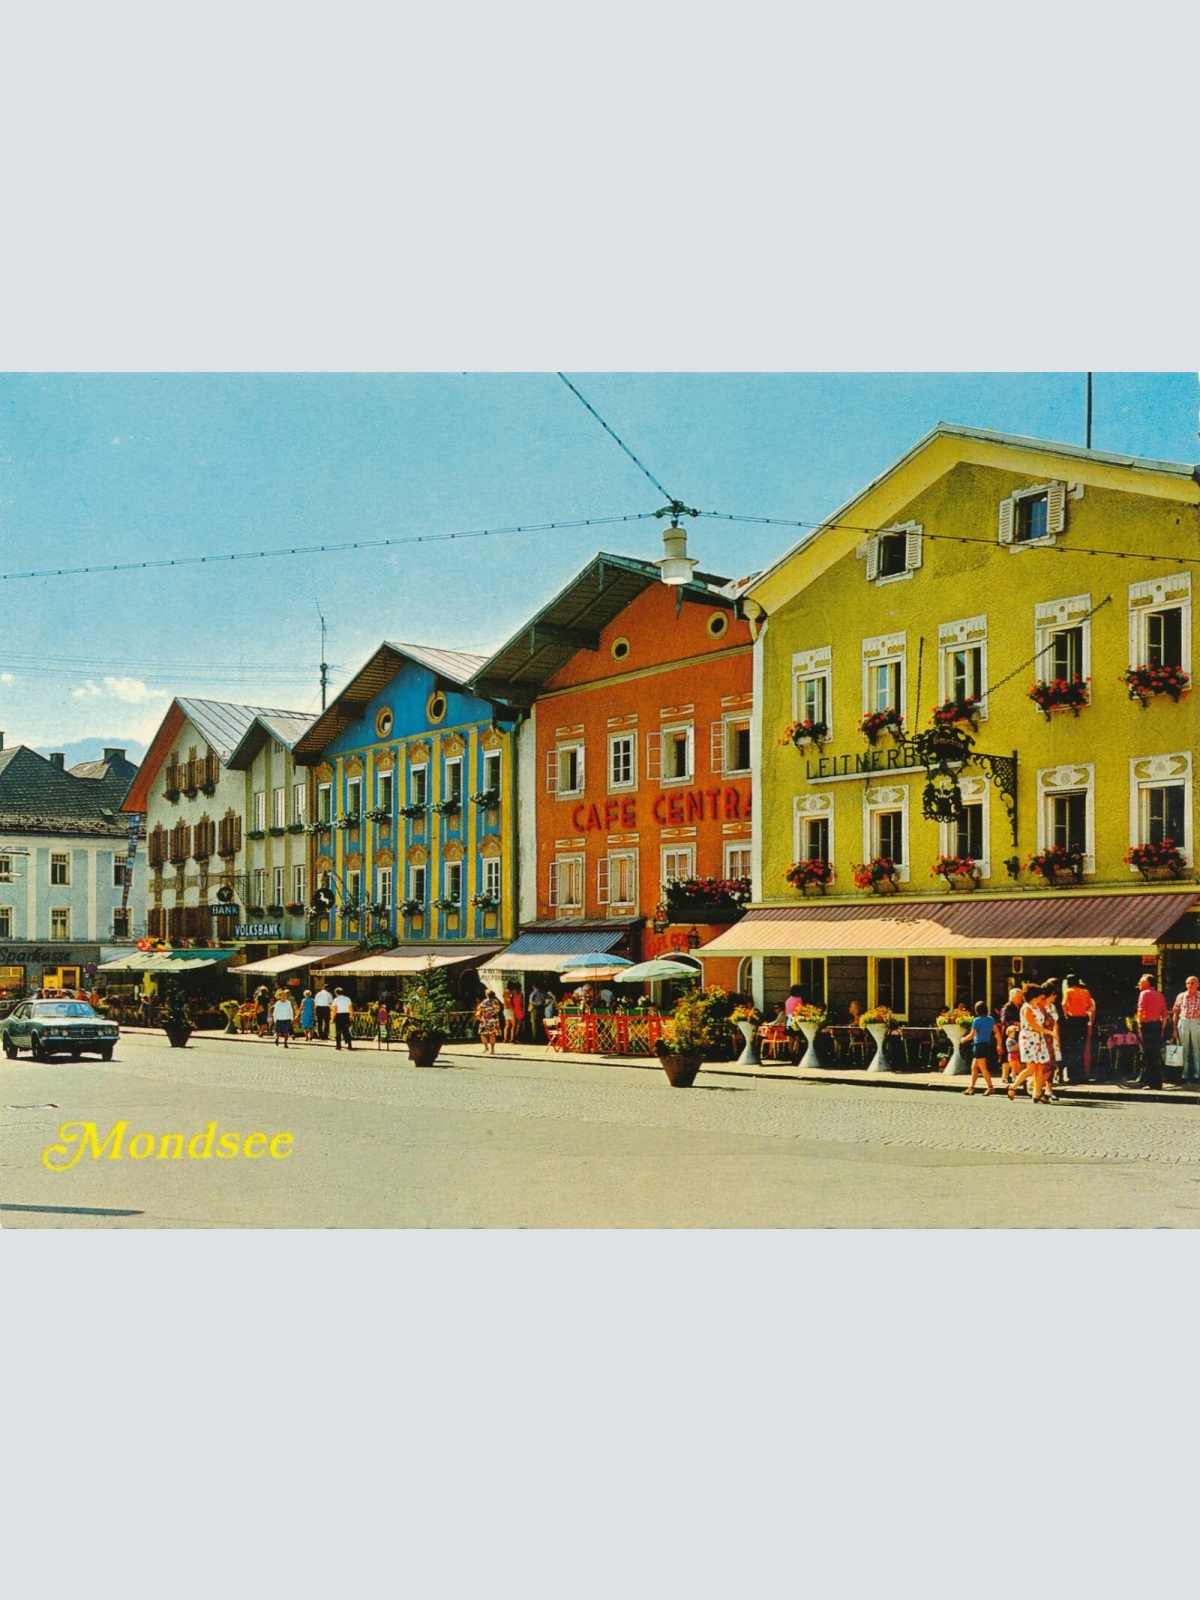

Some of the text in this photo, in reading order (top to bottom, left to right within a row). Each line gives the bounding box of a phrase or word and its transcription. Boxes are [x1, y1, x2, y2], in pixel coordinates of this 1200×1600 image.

[571, 799, 637, 832] CAFE
[213, 906, 238, 914] BANK
[235, 924, 278, 936] VOLKSBANK
[0, 946, 71, 964] Sparkasse
